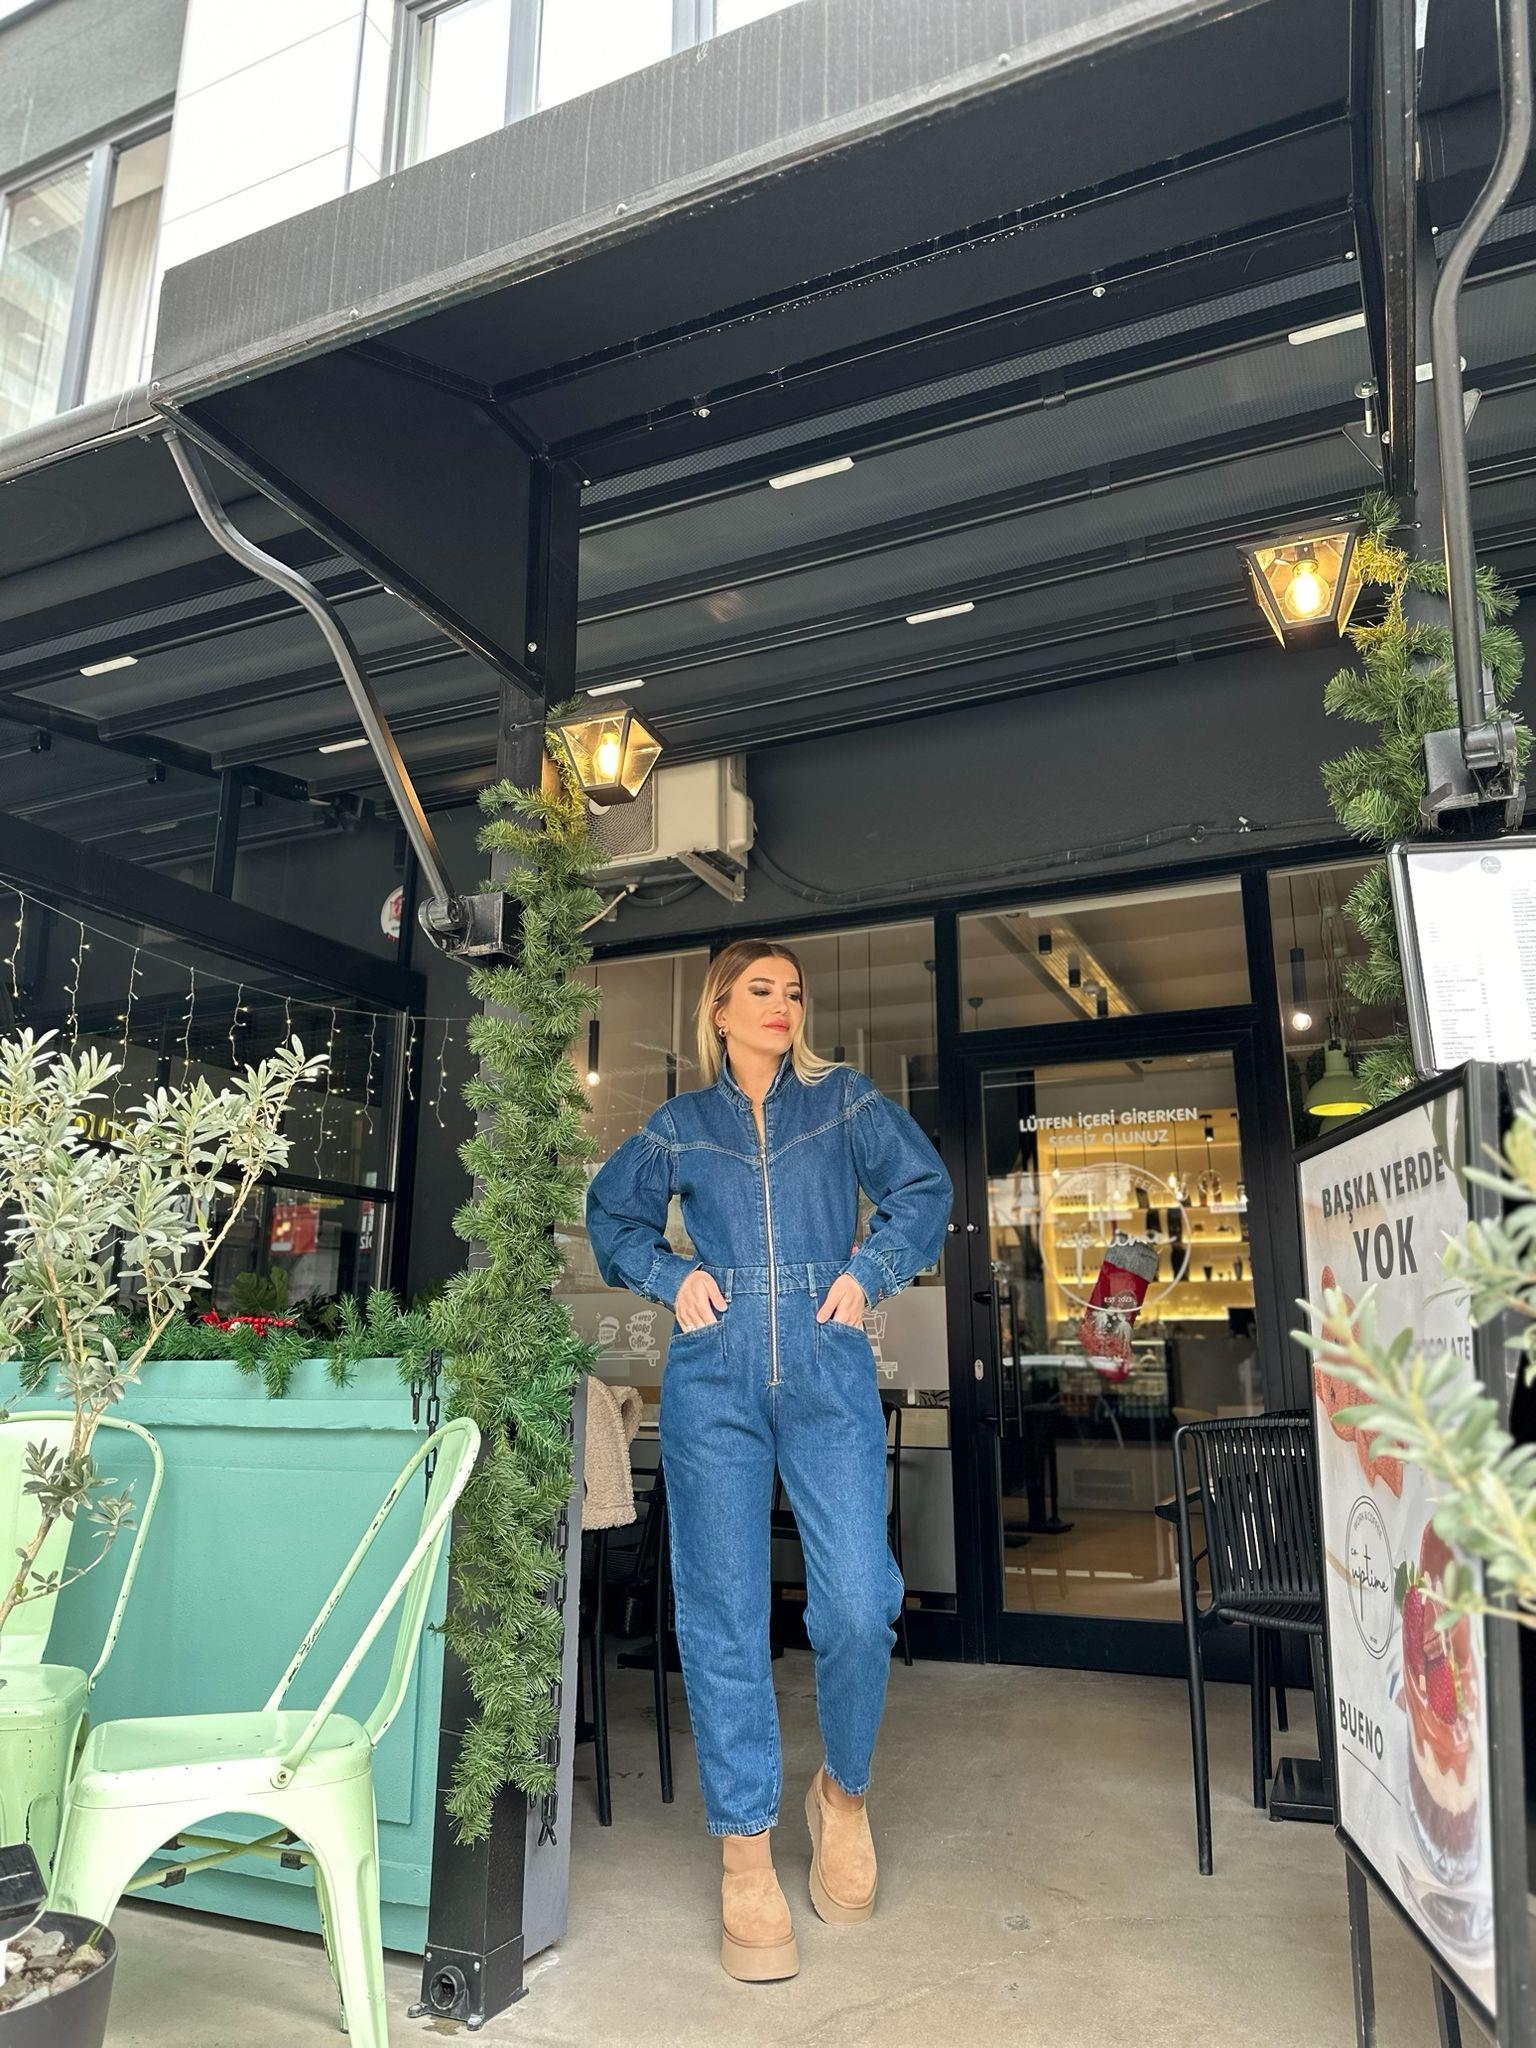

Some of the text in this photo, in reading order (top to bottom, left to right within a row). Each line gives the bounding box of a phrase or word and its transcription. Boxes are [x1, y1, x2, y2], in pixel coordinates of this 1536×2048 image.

[1019, 1107, 1198, 1132] LÜTFEN İÇERİ GİRERKEN
[1049, 1129, 1169, 1148] SESSİZ OLUNUZ
[1321, 1145, 1446, 1224] BAŞKA YERDE
[1352, 1215, 1418, 1282] YOK
[1352, 1543, 1389, 1622] uptime
[1339, 1697, 1384, 1761] BUENO
